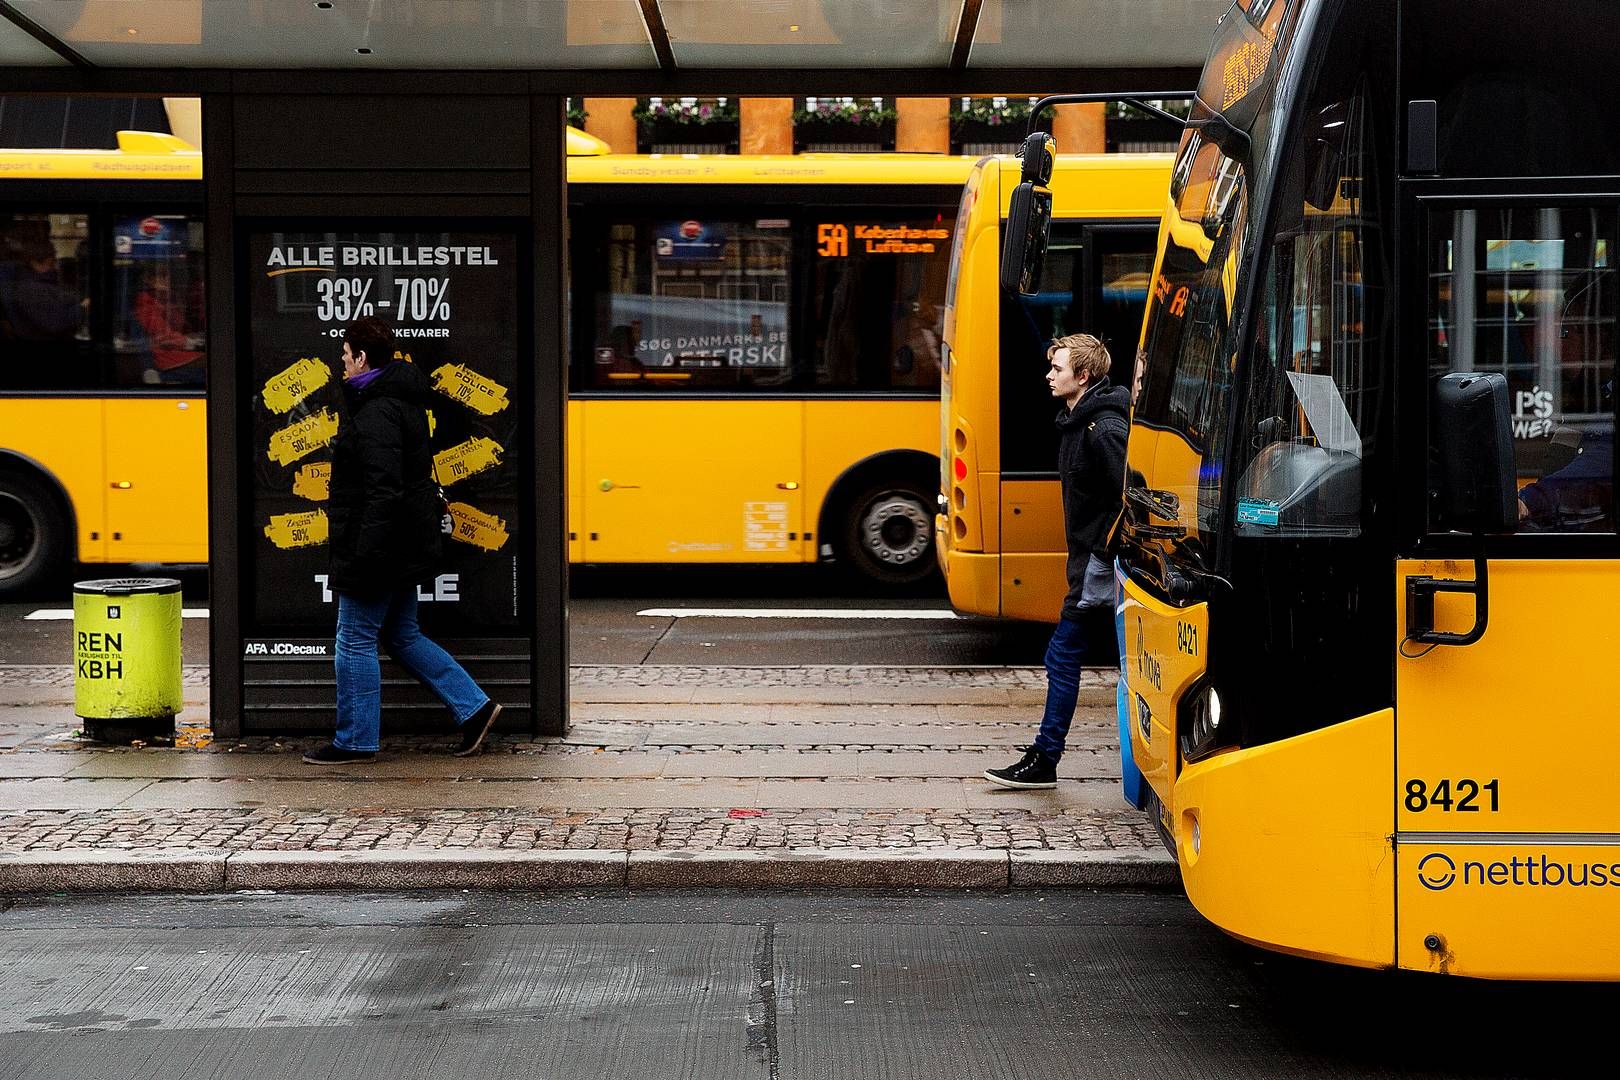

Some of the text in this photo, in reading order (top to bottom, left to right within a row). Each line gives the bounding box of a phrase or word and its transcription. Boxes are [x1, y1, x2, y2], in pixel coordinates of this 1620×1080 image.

[817, 223, 848, 256] 5A
[267, 247, 498, 266] ALLE BRILLESTEL
[392, 328, 450, 338] KEVARER
[676, 334, 763, 349] DANMARKS
[271, 364, 309, 392] GUCCI
[287, 379, 308, 397] 33%
[454, 371, 496, 397] POLICE
[456, 383, 475, 402] 70%
[279, 421, 318, 444] ESCADA
[291, 436, 312, 453] 50%
[449, 460, 469, 476] 70%
[291, 528, 310, 542] 50%
[459, 521, 479, 540] 50%
[314, 573, 460, 603] TLE
[78, 631, 122, 652] REN
[245, 643, 327, 655] AFA JCDecaux
[1177, 620, 1198, 657] 8421
[78, 659, 123, 680] KBH
[1143, 649, 1162, 693] movia
[1404, 778, 1500, 813] 8421
[1464, 854, 1620, 887] nettbuss
